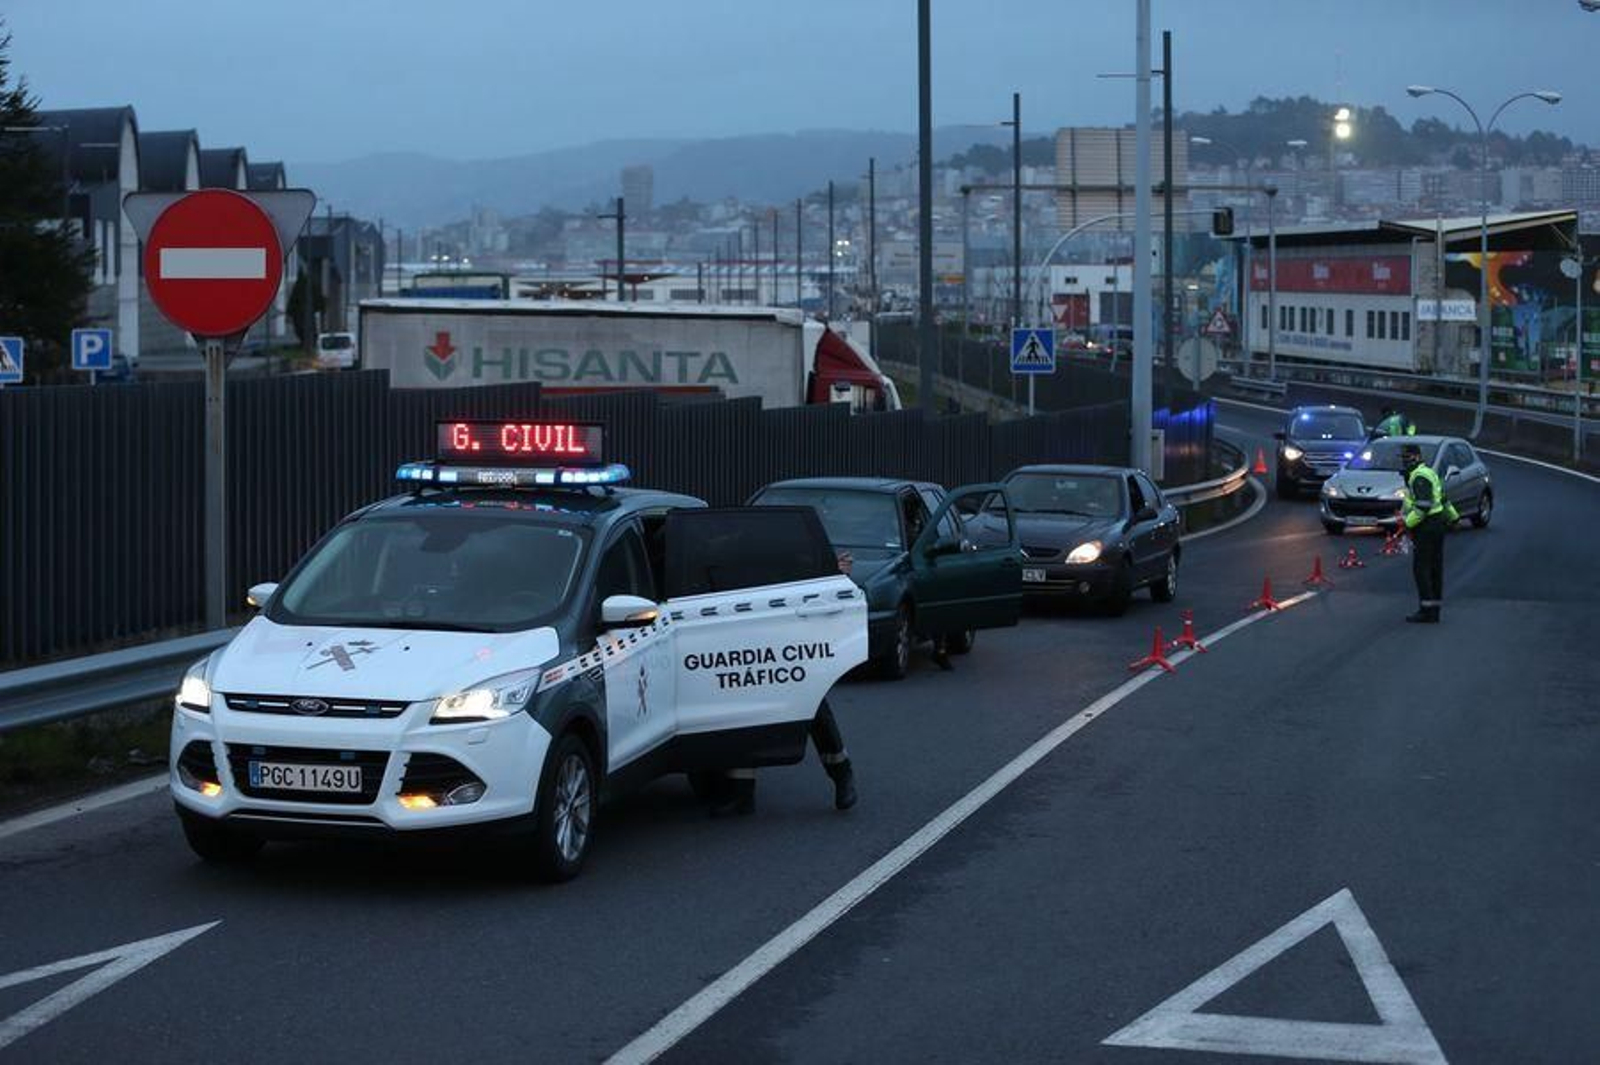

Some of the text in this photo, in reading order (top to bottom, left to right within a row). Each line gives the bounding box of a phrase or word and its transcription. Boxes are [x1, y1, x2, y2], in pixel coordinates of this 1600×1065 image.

[80, 334, 104, 364] P
[472, 346, 739, 384] HISANTA
[453, 423, 585, 452] G. CIVIL
[684, 642, 835, 670] GUARDIA CIVIL
[716, 666, 806, 689] TRÁFICO
